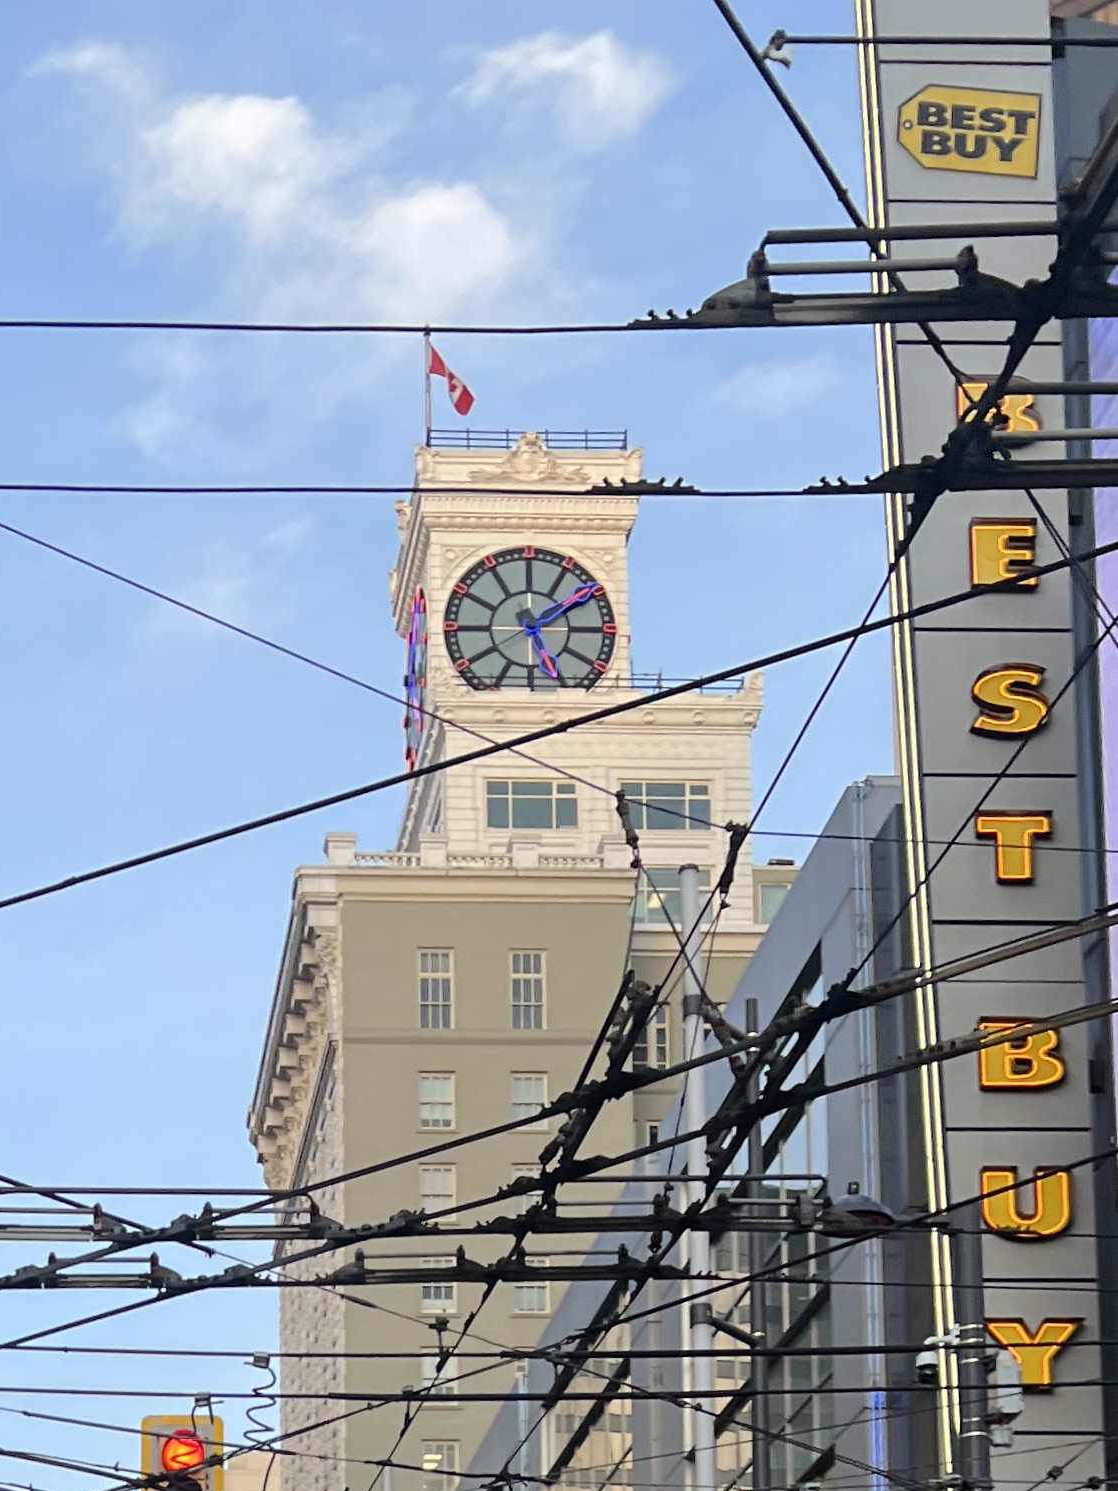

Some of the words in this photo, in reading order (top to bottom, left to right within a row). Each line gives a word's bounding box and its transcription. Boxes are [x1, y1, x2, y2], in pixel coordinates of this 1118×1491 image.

[917, 101, 1036, 136] BEST
[920, 129, 1025, 162] BUY
[956, 374, 1053, 885] BEST
[978, 1016, 1086, 1393] BUY
